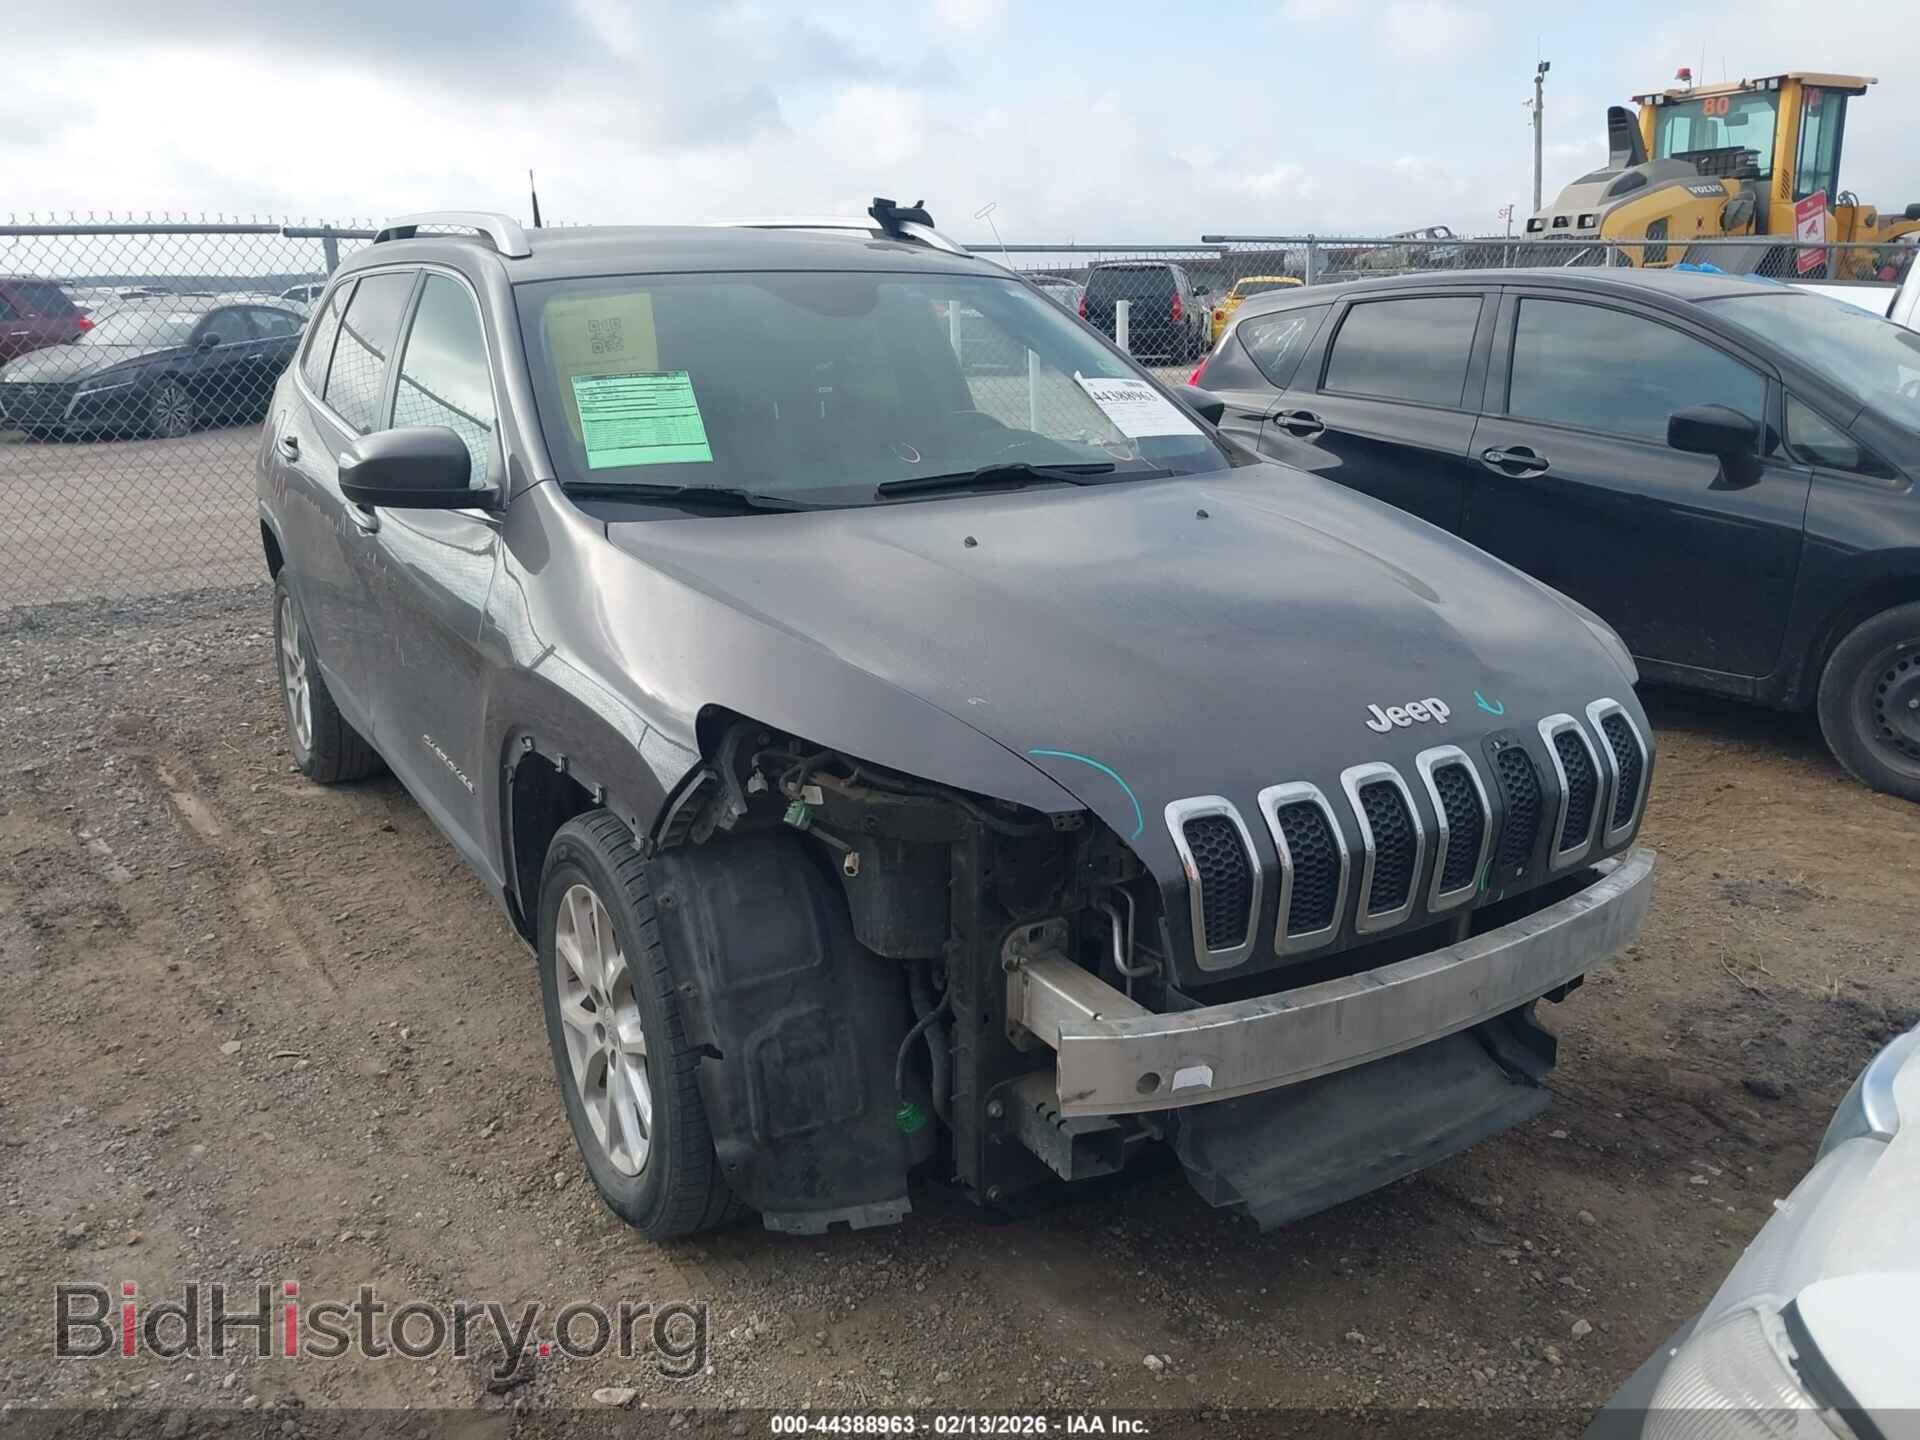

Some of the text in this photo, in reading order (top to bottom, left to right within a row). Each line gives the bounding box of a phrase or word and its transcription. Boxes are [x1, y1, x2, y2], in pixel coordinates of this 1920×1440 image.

[1704, 97, 1728, 116] 80
[1688, 184, 1724, 193] VOLVO
[1366, 697, 1450, 733] Jeep
